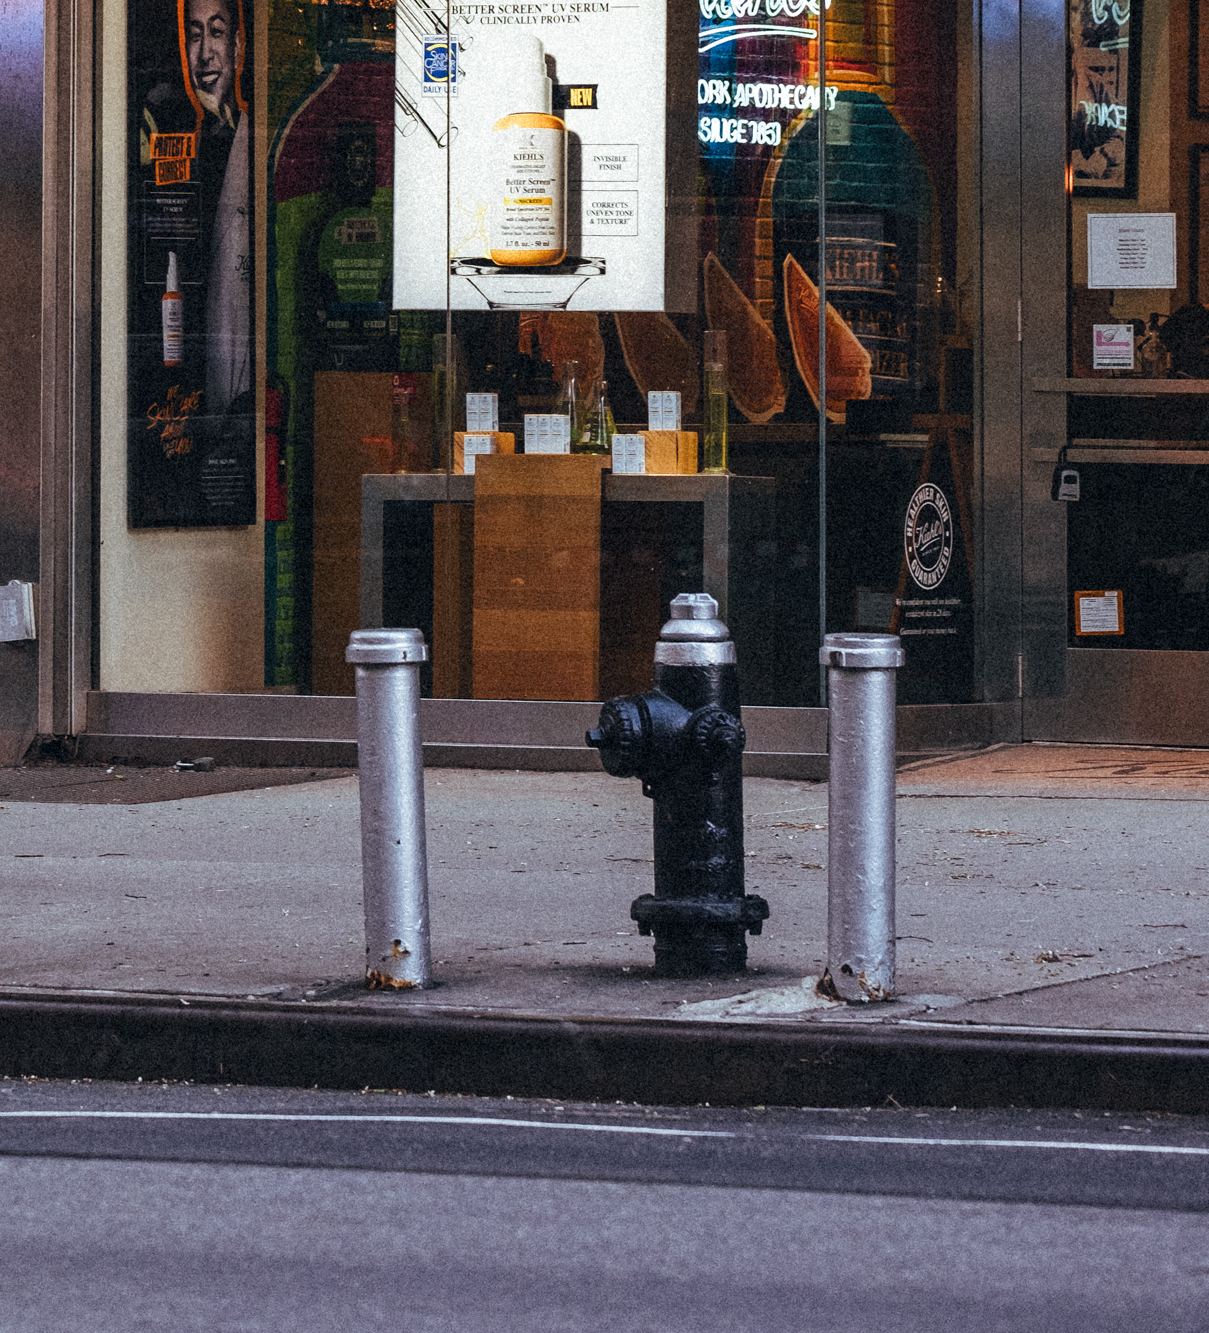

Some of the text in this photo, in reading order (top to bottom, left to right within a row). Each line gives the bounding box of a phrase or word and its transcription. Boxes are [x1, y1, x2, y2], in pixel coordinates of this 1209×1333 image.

[451, 5, 495, 15] BETTER
[551, 4, 568, 13] UV
[569, 3, 609, 13] SERUM
[480, 15, 580, 25] CLINICALLY PROVEN
[423, 86, 457, 94] DAILY UE
[570, 88, 593, 107] NEW
[698, 79, 731, 104] ORK
[906, 487, 950, 537] HEALTHIER SKIN
[910, 546, 950, 585] GUARANTEED
